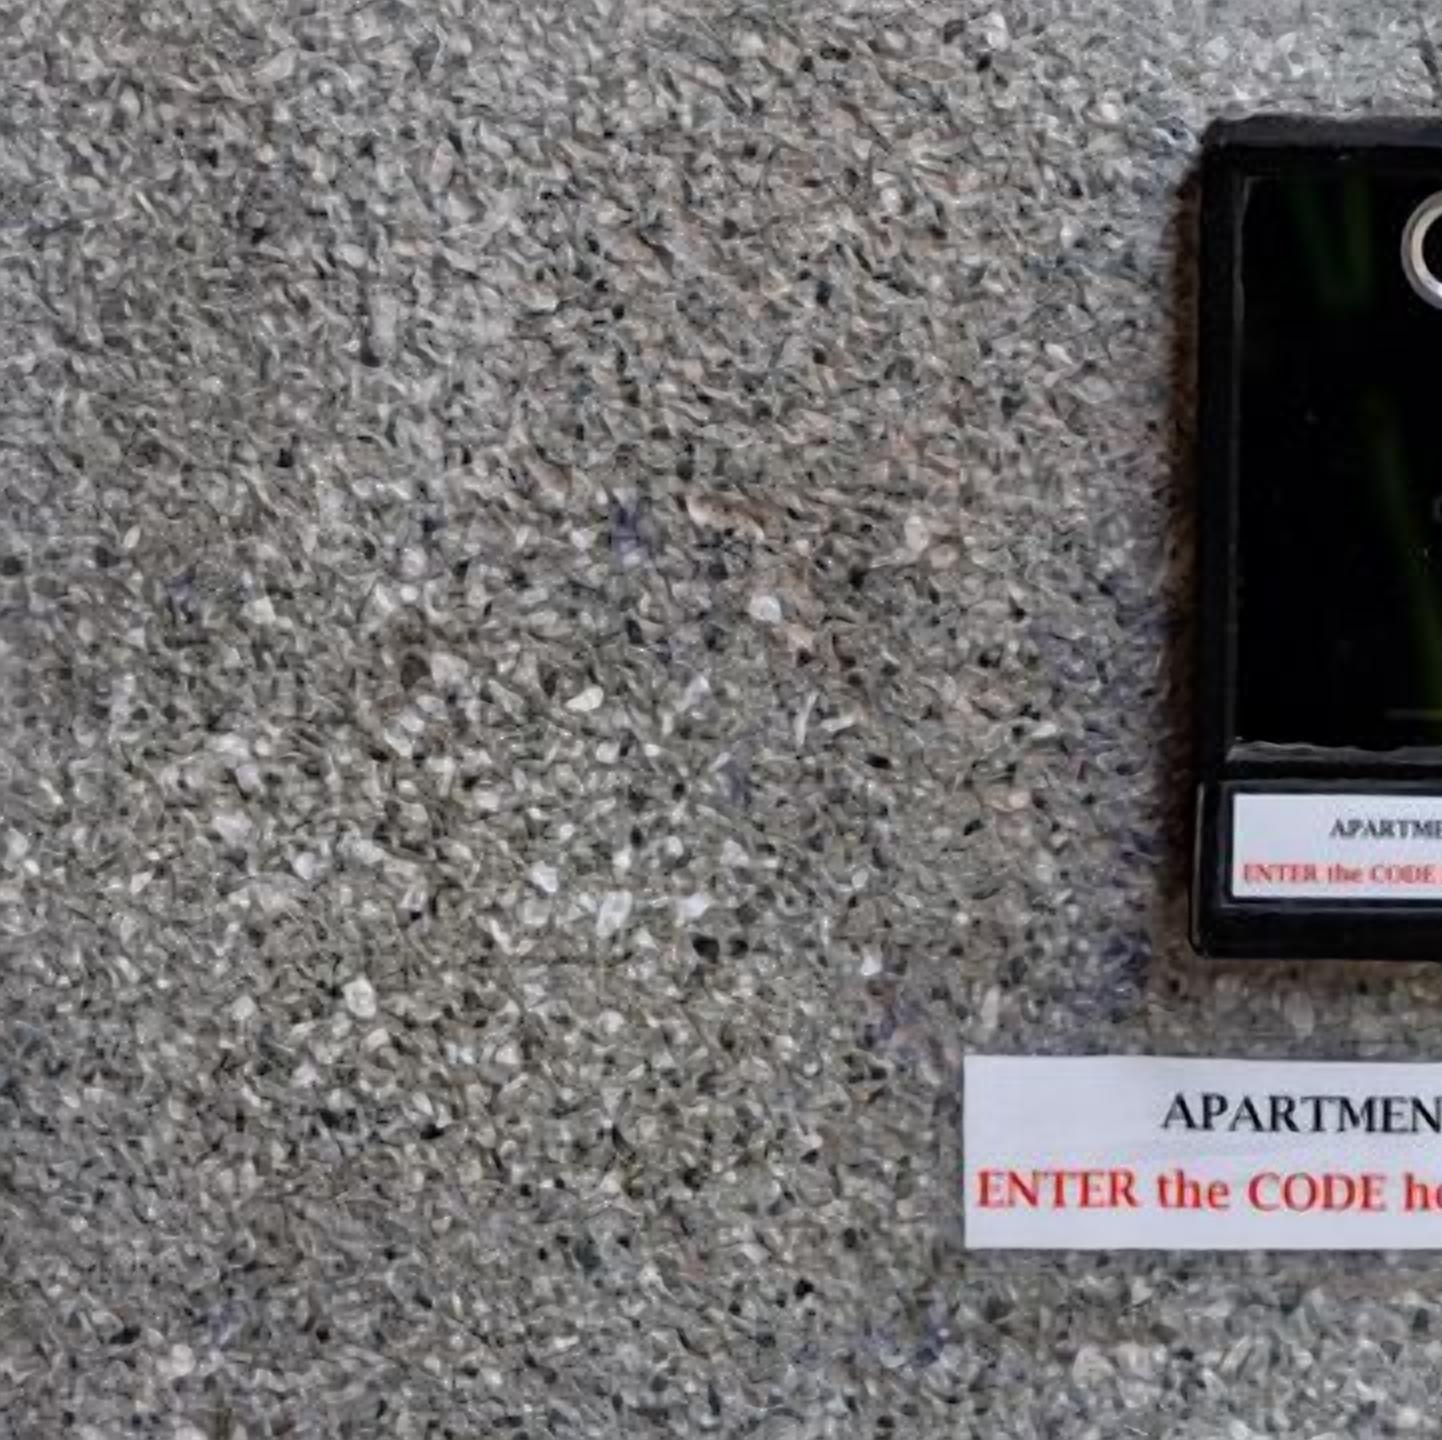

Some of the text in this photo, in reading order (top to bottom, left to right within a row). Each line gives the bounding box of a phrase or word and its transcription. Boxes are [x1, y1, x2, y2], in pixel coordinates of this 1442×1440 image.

[1243, 863, 1318, 884] ENTER
[1328, 864, 1364, 885] the
[1369, 865, 1436, 886] CODE
[977, 1167, 1139, 1211] ENTER
[1157, 1170, 1232, 1212] the
[1248, 1173, 1387, 1213] CODE
